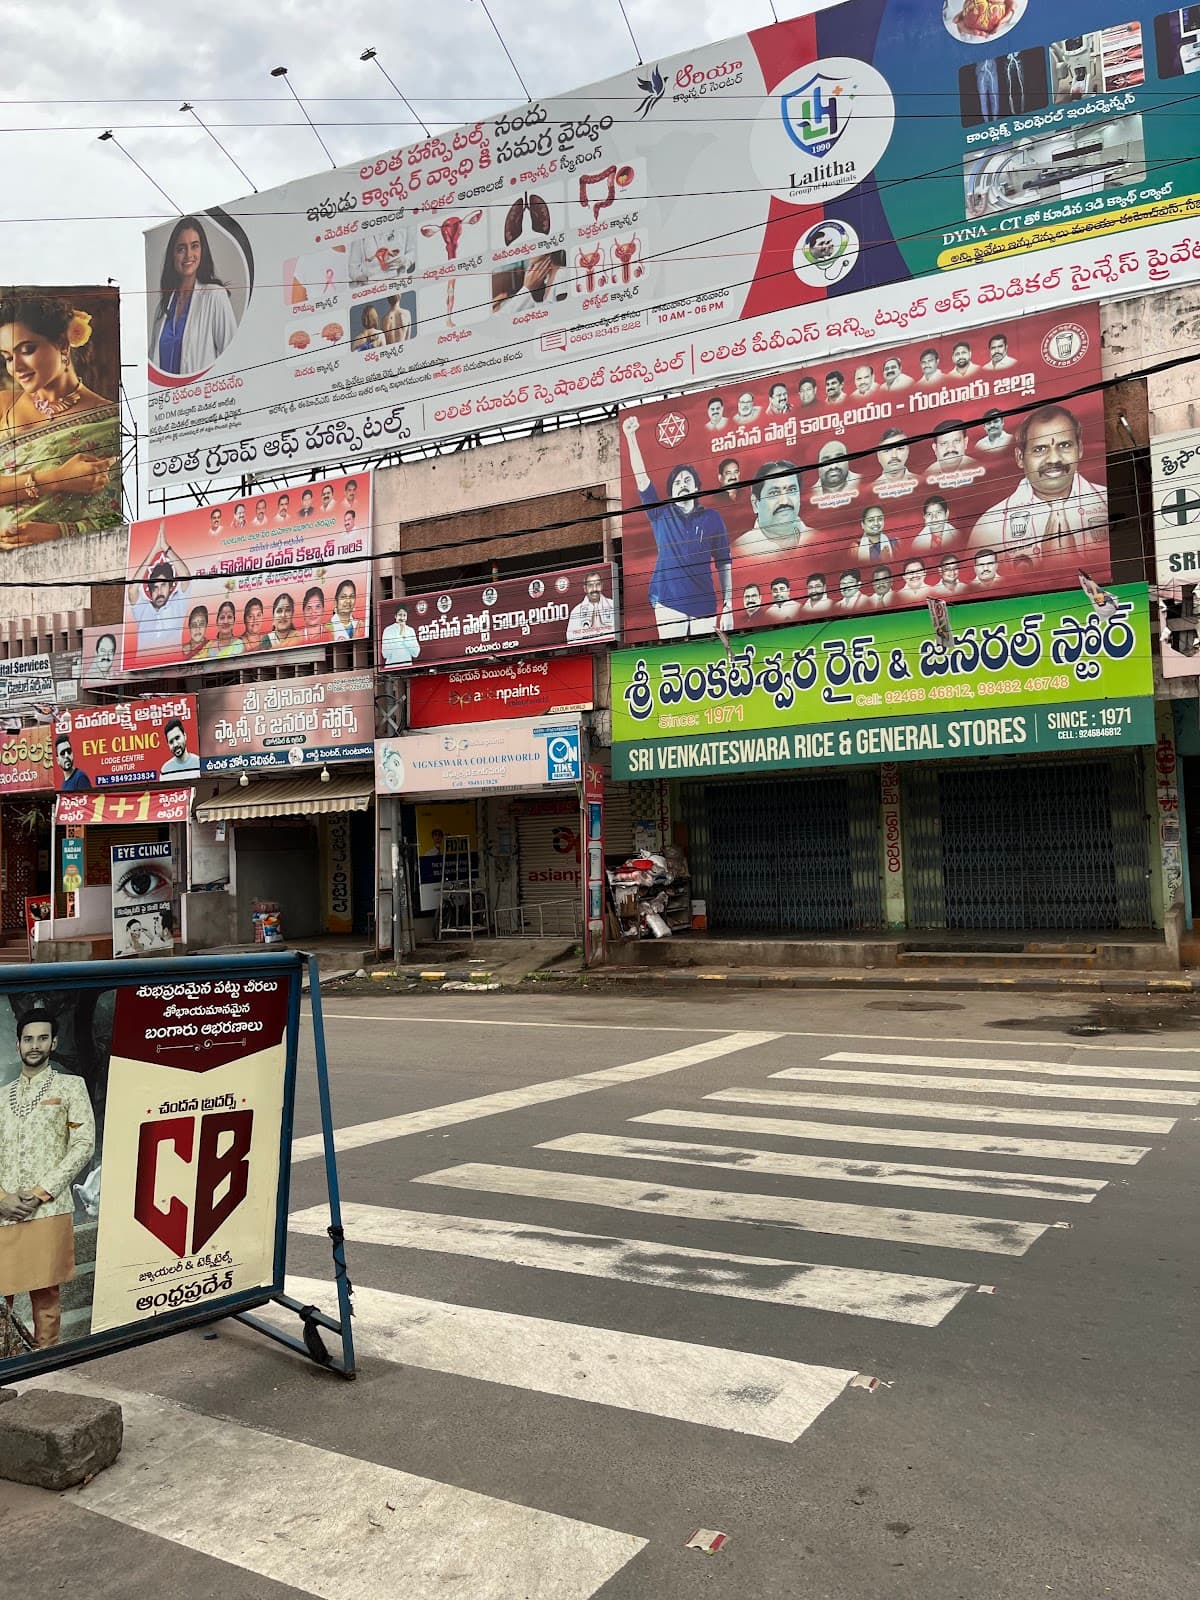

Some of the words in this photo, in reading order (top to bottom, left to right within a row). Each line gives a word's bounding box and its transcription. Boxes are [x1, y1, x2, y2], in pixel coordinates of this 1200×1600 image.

[674, 59, 743, 89] ఆరియా
[359, 150, 403, 180] లలిత
[407, 121, 490, 163] హాస్పిటల్స్
[494, 103, 547, 137] నందు
[361, 169, 422, 207] క్యాన్సర్
[496, 128, 552, 163] సమగ్ర
[557, 113, 613, 151] వైద్యం
[519, 159, 558, 183] క్యాన్సర్
[789, 158, 856, 189] Lalitha
[942, 225, 989, 246] DYNA
[999, 214, 1022, 232] CT
[657, 312, 669, 324] 10
[669, 309, 686, 321] AM
[694, 304, 708, 315] 06
[708, 300, 725, 312] PM
[700, 338, 747, 364] లలిత
[752, 321, 820, 353] పీవీఎస్
[934, 288, 971, 314] ఆఫ్
[977, 266, 1064, 305] మెడికల్
[433, 399, 472, 422] లలిత
[475, 385, 529, 412] సూపర్
[533, 366, 605, 404] స్పెషాలిటీ
[609, 350, 685, 383] హాస్పిటల్
[710, 422, 761, 452] జనసేన
[764, 416, 797, 445] పార్టీ
[799, 399, 892, 435] కార్యాలయం
[152, 449, 200, 477] లలిత
[205, 437, 257, 474] గ్రూప్
[263, 428, 299, 459] ఆఫ్
[305, 406, 411, 451] హాస్పిటల్స్
[265, 546, 293, 568] పవన్
[296, 539, 335, 562] కళ్యాణ్
[337, 538, 363, 557] గారికి
[418, 616, 461, 642] జనసేన
[463, 609, 491, 642] పార్టీ
[493, 602, 569, 635] కార్యాలయం
[14, 659, 49, 674] Services
[624, 659, 655, 721] శ్రీ
[658, 643, 819, 711] వెంకటేశ్వర
[821, 634, 881, 705] రైస్
[888, 648, 913, 681] &
[920, 613, 1044, 678] జనరల్
[1051, 602, 1137, 682] స్టోర్
[243, 688, 260, 715] శ్రీ
[263, 682, 325, 713] శ్రీనివాస
[885, 688, 926, 705] 92468
[977, 678, 1021, 695] 98482
[1023, 675, 1070, 692] 46748
[270, 708, 319, 735] జనరల్
[321, 704, 358, 738] స్టోర్స్
[658, 713, 700, 729] Since:
[704, 704, 744, 725] 1971
[1047, 710, 1088, 730] SINCE
[1099, 706, 1132, 726] 1971
[82, 738, 107, 756] EYE
[111, 732, 161, 753] CLINIC
[549, 737, 578, 763] ON
[628, 747, 654, 772] SRI
[656, 735, 791, 770] VENKATESWARA
[794, 731, 835, 759] RICE
[838, 730, 853, 756] &
[856, 723, 945, 755] GENERAL
[947, 716, 1027, 748] STORES
[1057, 730, 1075, 740] CELL
[100, 756, 121, 765] LODGE
[111, 763, 135, 772] GUNTUR
[206, 760, 229, 771] ఉచిత
[553, 763, 573, 773] TIME
[90, 792, 151, 822] 1+1
[117, 848, 135, 859] EYE
[138, 844, 169, 857] CLINIC
[136, 981, 212, 1000] శుభప్రదమైన
[213, 981, 242, 999] పట్టు
[243, 979, 278, 993] చీరలు
[162, 1002, 250, 1018] శోభాయమానమైన
[144, 1023, 198, 1039] బంగారు
[200, 1020, 263, 1036] ఆభరణాలు
[158, 1098, 198, 1115] చందన
[200, 1092, 237, 1112] బ్రదర్స్
[134, 1109, 254, 1258] CB
[185, 1261, 194, 1270] &
[136, 1270, 234, 1311] ఆంధ్రప్రదేశ్
